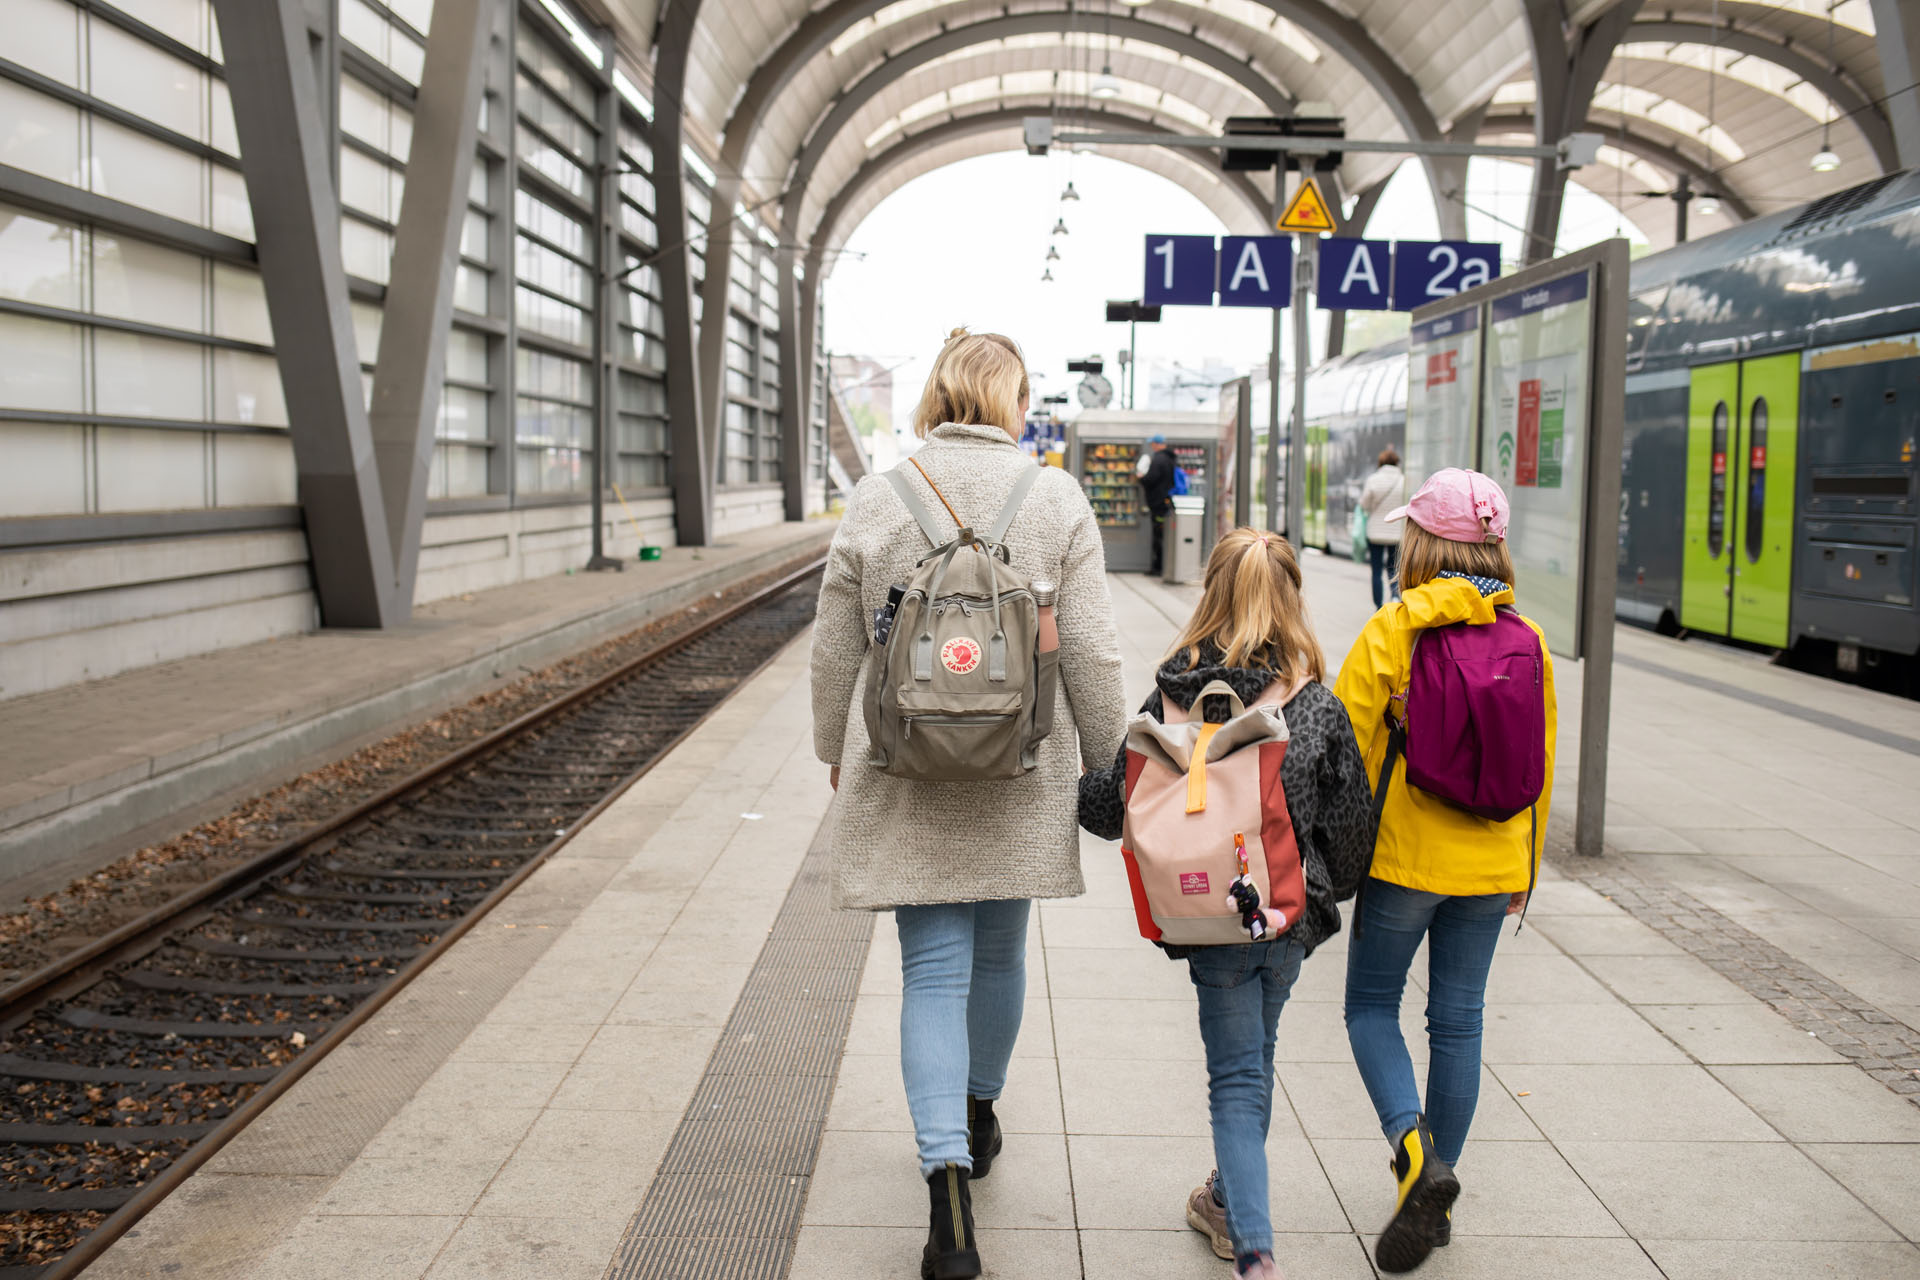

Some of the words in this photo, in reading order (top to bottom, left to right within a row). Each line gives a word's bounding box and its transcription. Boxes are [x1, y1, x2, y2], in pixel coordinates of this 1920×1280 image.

[1154, 239, 1174, 290] 1
[1229, 241, 1270, 292] A
[1339, 244, 1380, 295] A
[1425, 245, 1490, 296] 2a
